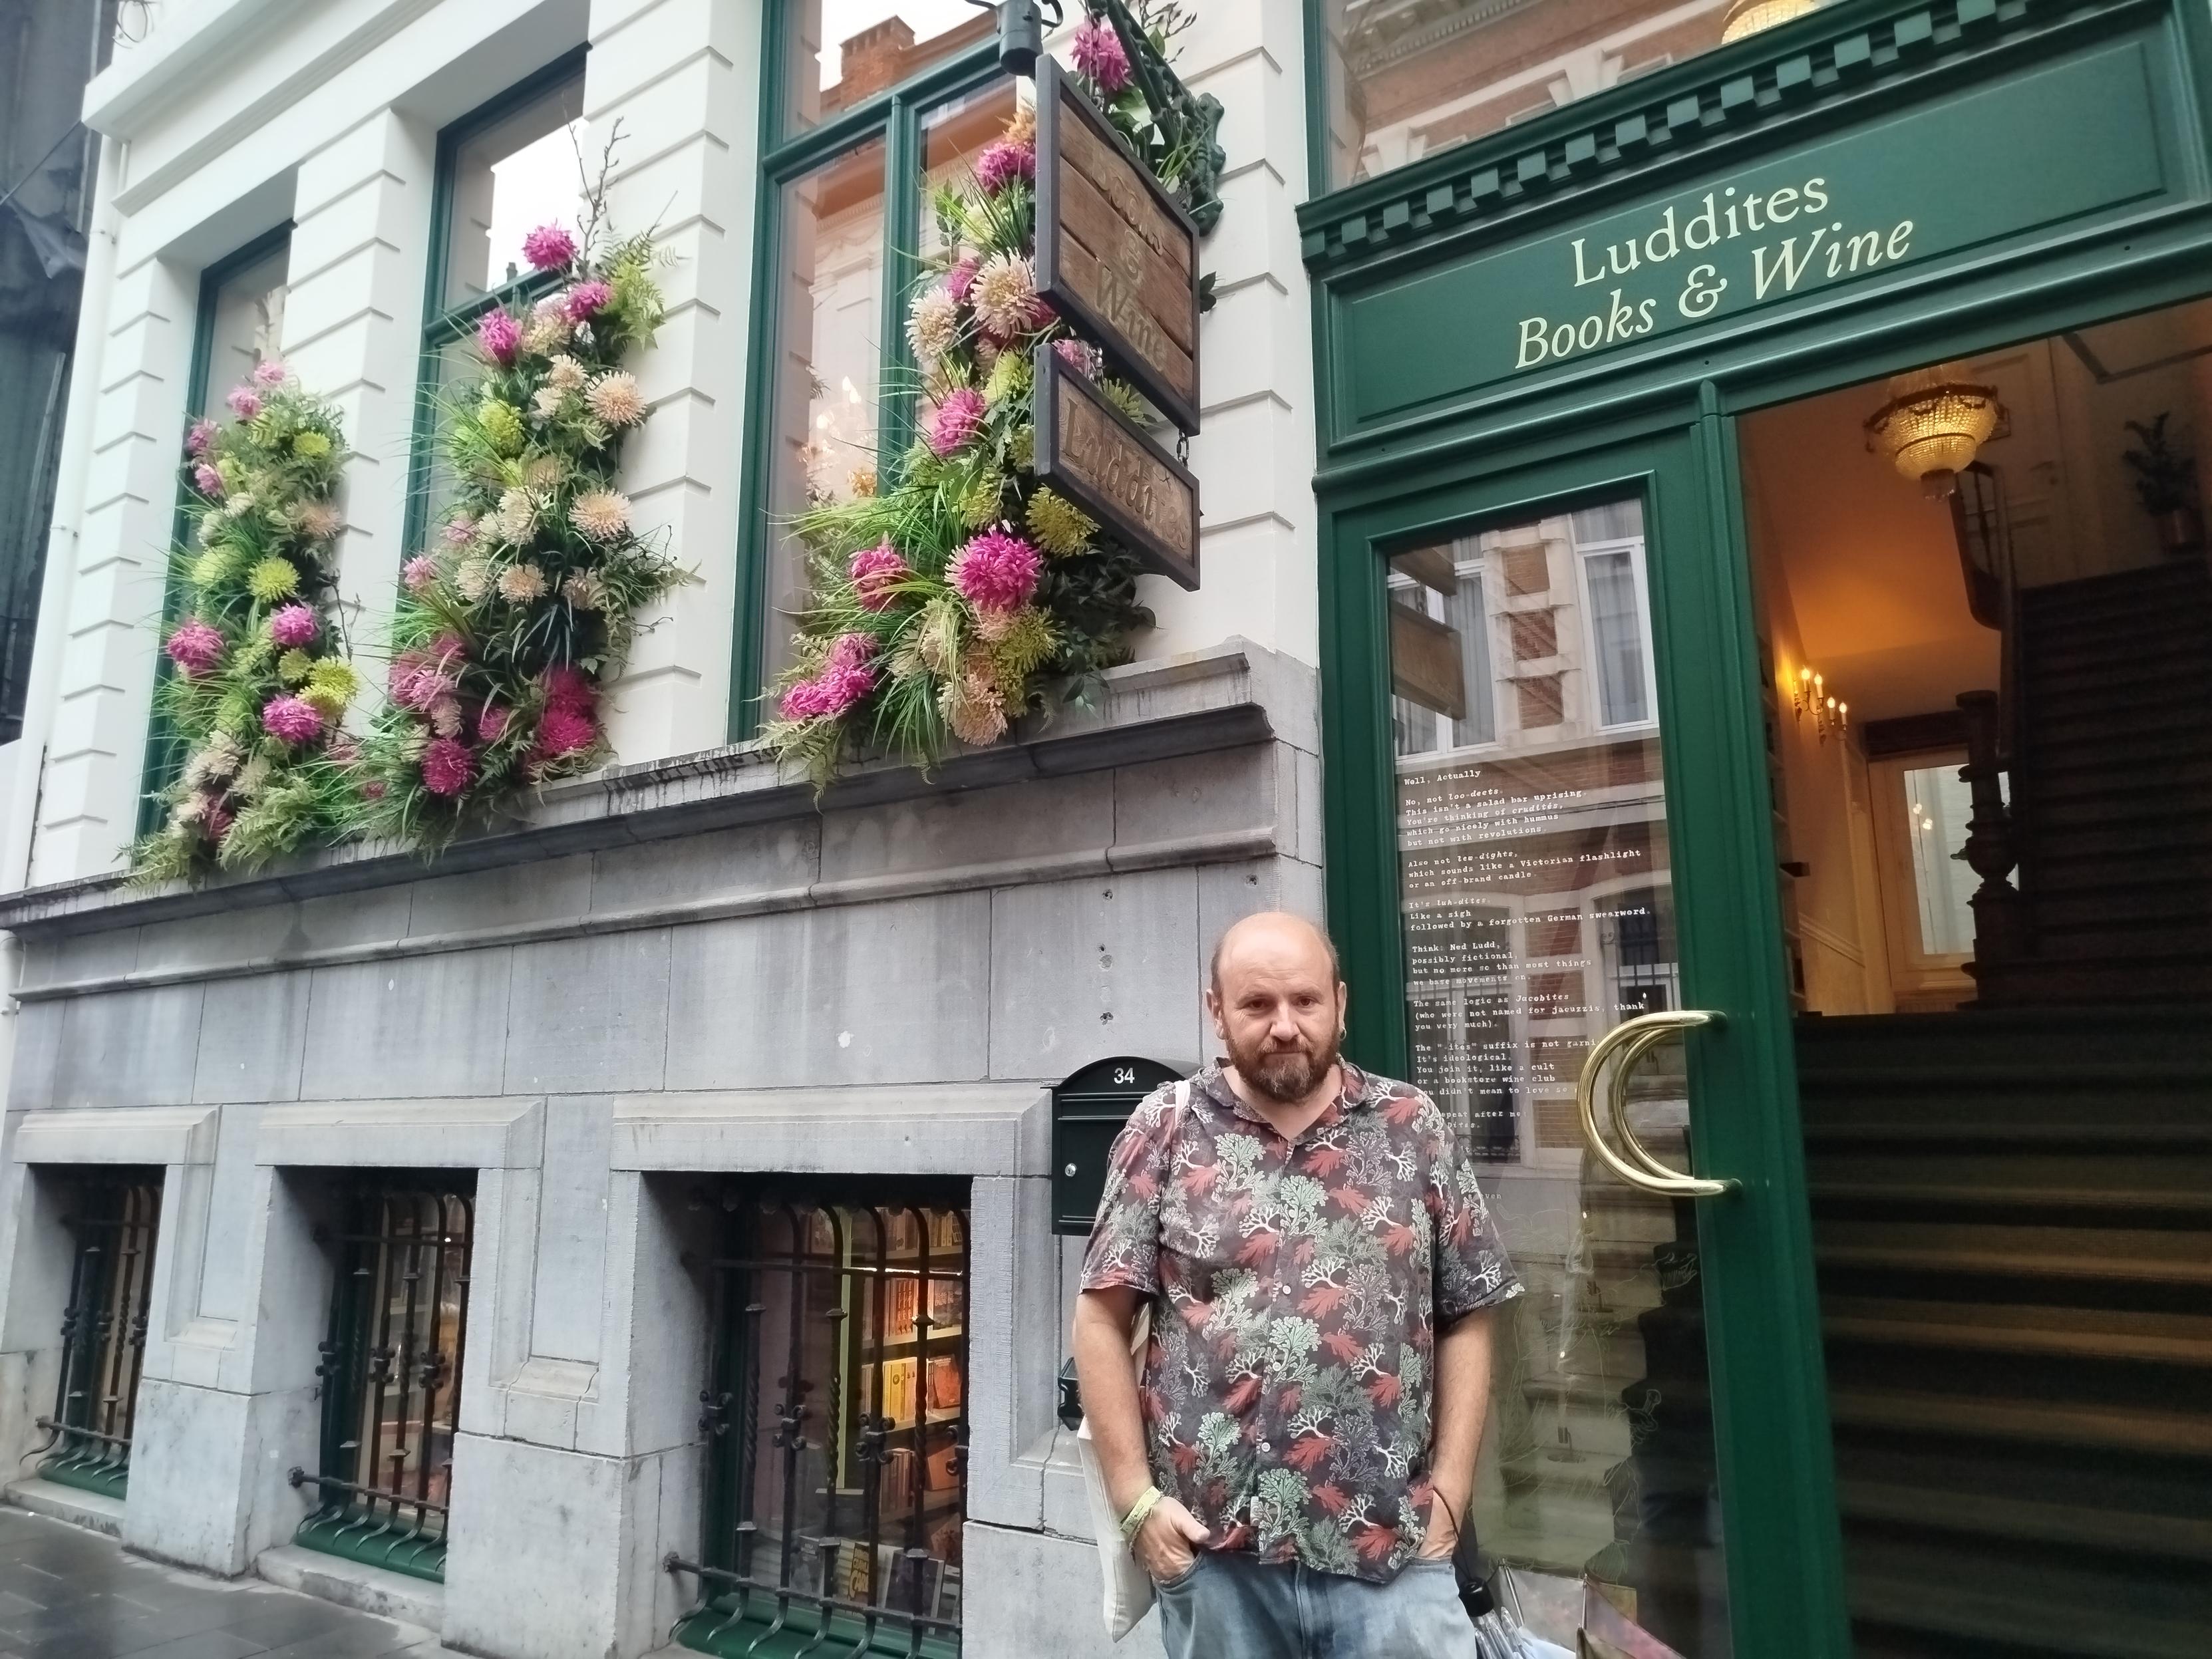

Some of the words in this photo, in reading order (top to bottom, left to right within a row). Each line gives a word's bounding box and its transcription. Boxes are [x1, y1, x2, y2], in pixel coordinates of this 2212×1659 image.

[1571, 178, 1828, 287] Luddites
[1515, 288, 1657, 369] Books
[1678, 264, 1727, 318] &
[1752, 220, 1914, 300] Wine
[1098, 267, 1169, 374] Wine
[1064, 398, 1187, 550] Luddites
[1404, 776, 1430, 786] Well,
[1437, 770, 1481, 782] Actually
[1406, 808, 1427, 816] This
[1434, 804, 1460, 812] isn't
[1477, 798, 1505, 808] salad
[1533, 790, 1587, 802] uprising.
[1407, 817, 1438, 826] You're
[1444, 811, 1489, 822] thinking
[1407, 828, 1433, 836] which
[1456, 822, 1489, 831] nicely
[1494, 818, 1518, 827] with
[1524, 814, 1559, 823] hummus
[1450, 833, 1472, 843] with
[1408, 869, 1435, 878] which
[1441, 866, 1474, 875] sounds
[1520, 857, 1574, 867] Victorian
[1579, 849, 1641, 862] flashlight
[1441, 875, 1492, 886] off-brand
[1410, 911, 1430, 919] Like
[1410, 921, 1454, 931] followed
[1489, 915, 1541, 927] forgotten
[1547, 913, 1583, 922] German
[1589, 907, 1651, 919] swearword.
[1412, 955, 1456, 965] possibly
[1462, 952, 1517, 962] fictional,
[1556, 959, 1592, 967] things
[1456, 975, 1507, 984] movements
[1464, 997, 1492, 1006] logic
[1415, 1012, 1435, 1020] (who
[1552, 1004, 1605, 1014] jacuzzis,
[1614, 1002, 1645, 1011] thank
[1464, 1019, 1498, 1028] much).
[1483, 1041, 1518, 1050] suffix
[1114, 1068, 1135, 1084] 34
[1438, 1066, 1461, 1074] join
